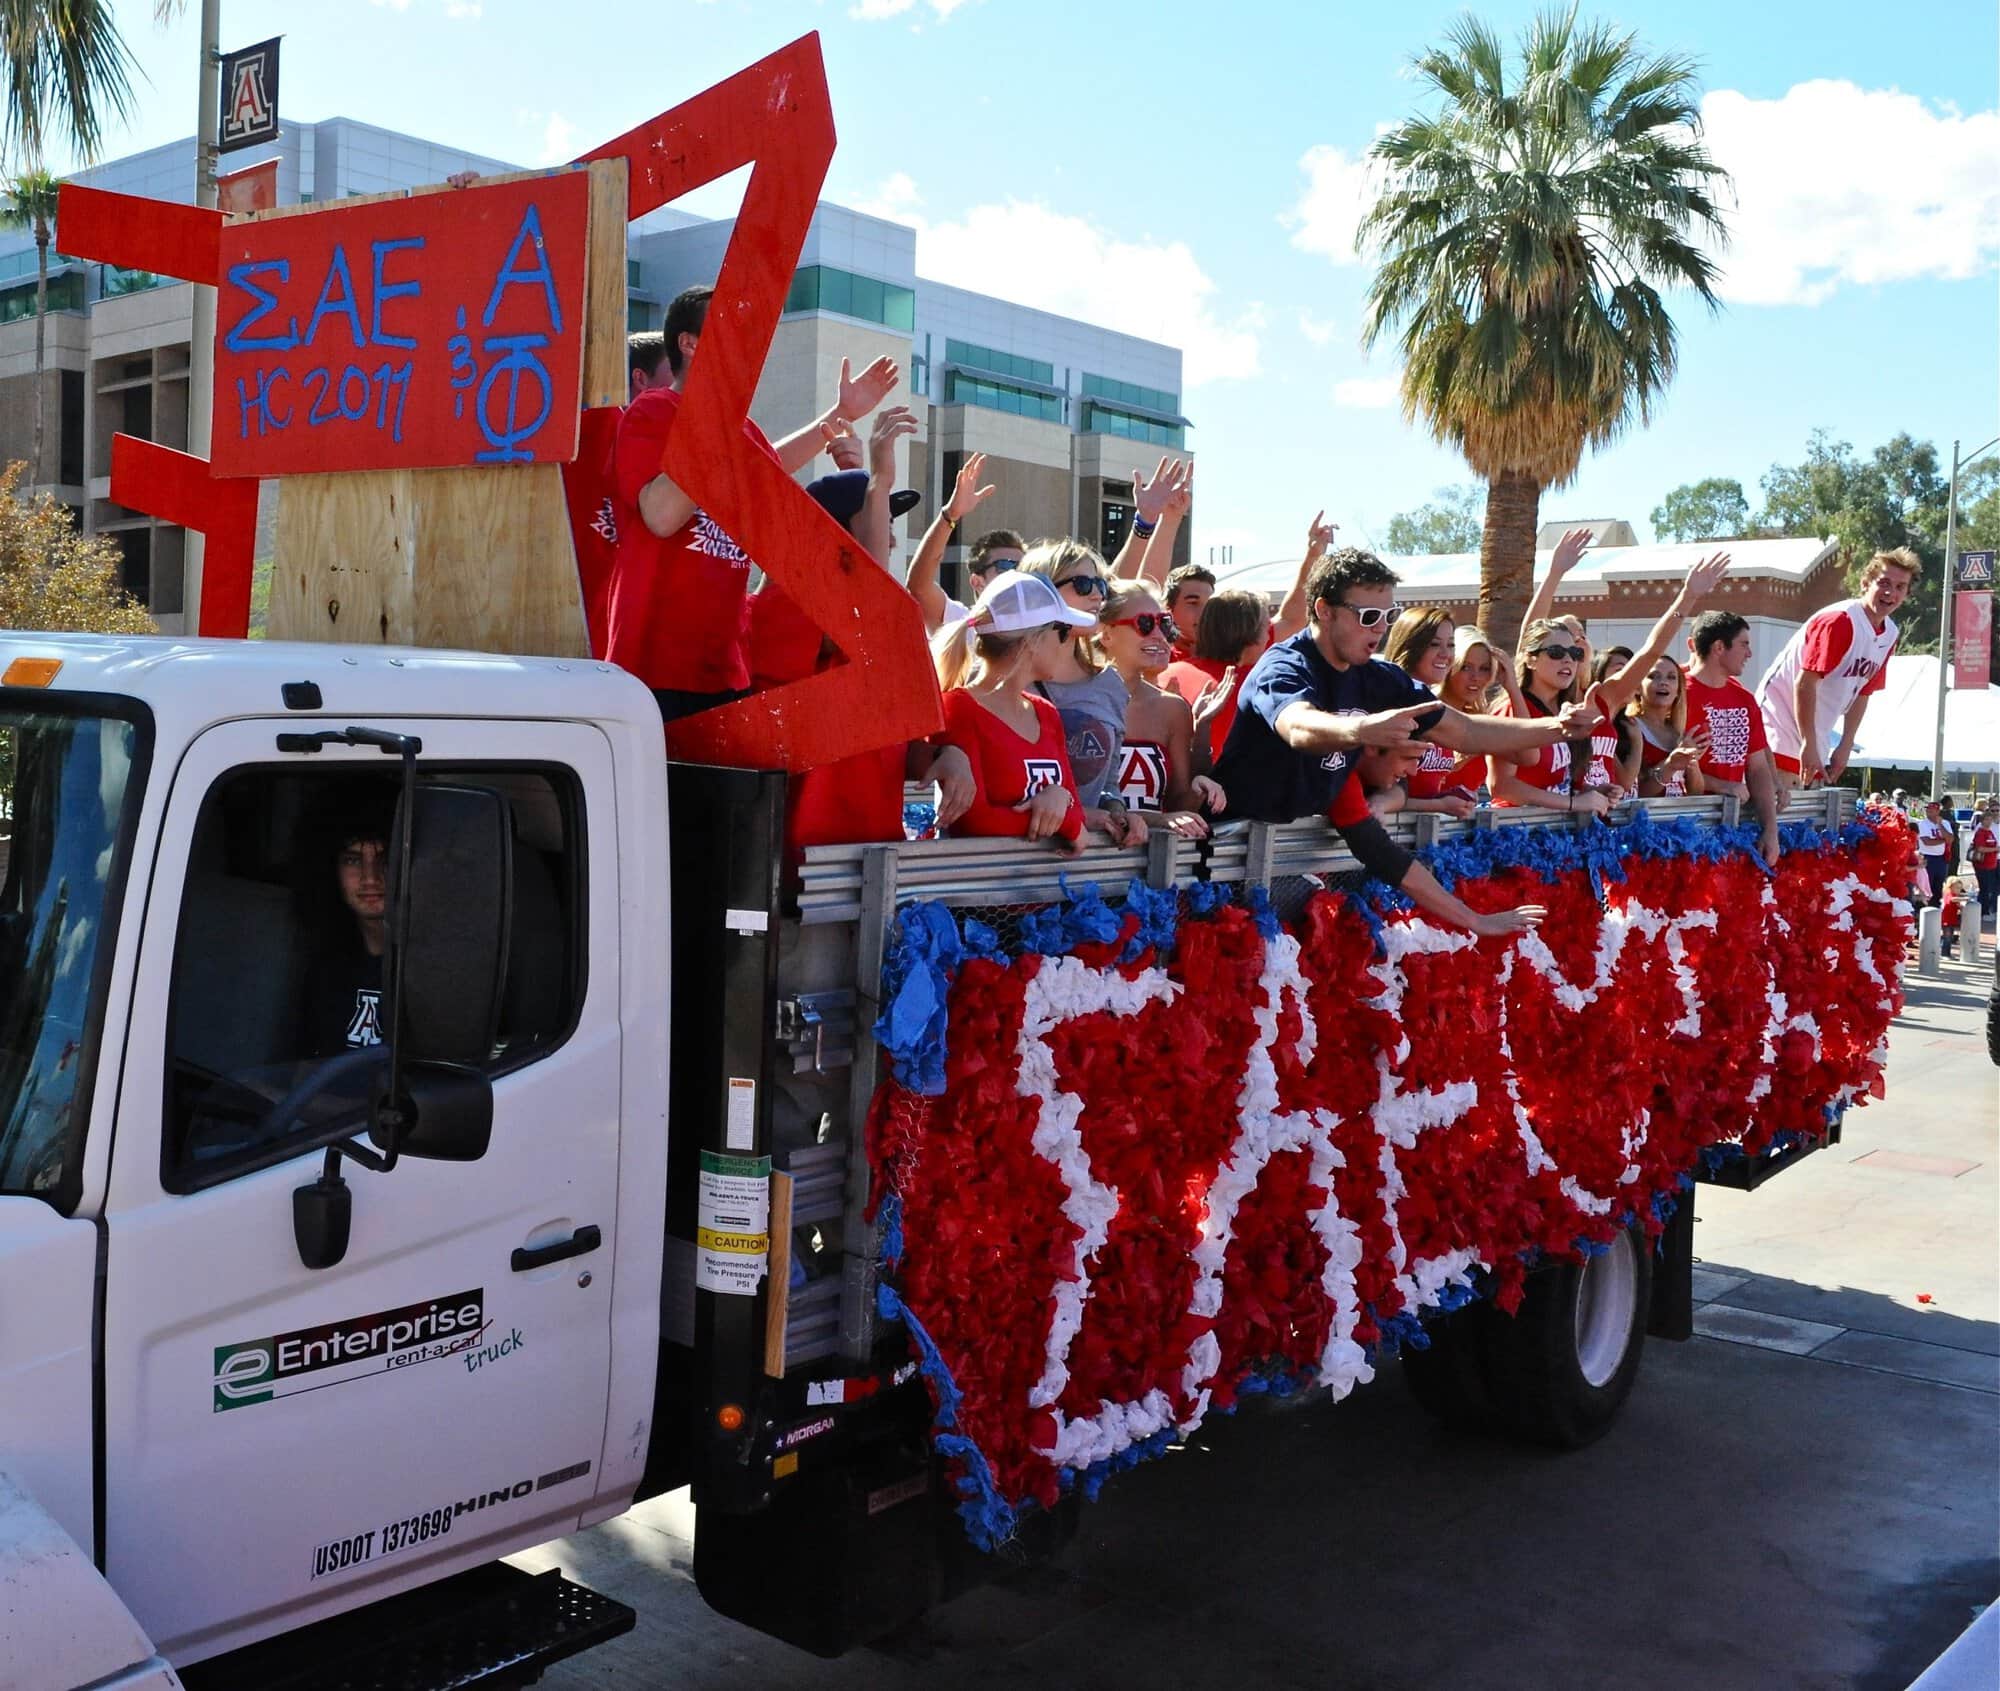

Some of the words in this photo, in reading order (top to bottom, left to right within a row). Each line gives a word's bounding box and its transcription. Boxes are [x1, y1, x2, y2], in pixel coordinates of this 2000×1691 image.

[223, 52, 273, 142] A
[237, 367, 294, 439] HC
[303, 361, 413, 443] 2011
[1961, 554, 1991, 581] A
[1117, 742, 1166, 814] A
[714, 1236, 765, 1250] CAUTION
[705, 1256, 759, 1270] Recommended
[706, 1266, 720, 1275] Tire
[721, 1269, 755, 1279] Pressure
[736, 1280, 750, 1288] PSI
[277, 1302, 481, 1373] Enterprise
[386, 1335, 480, 1369] rent-a-car
[463, 1327, 524, 1373] truck
[454, 1479, 533, 1517] HINO
[315, 1531, 376, 1576] USDOT
[381, 1505, 453, 1554] 1373698
